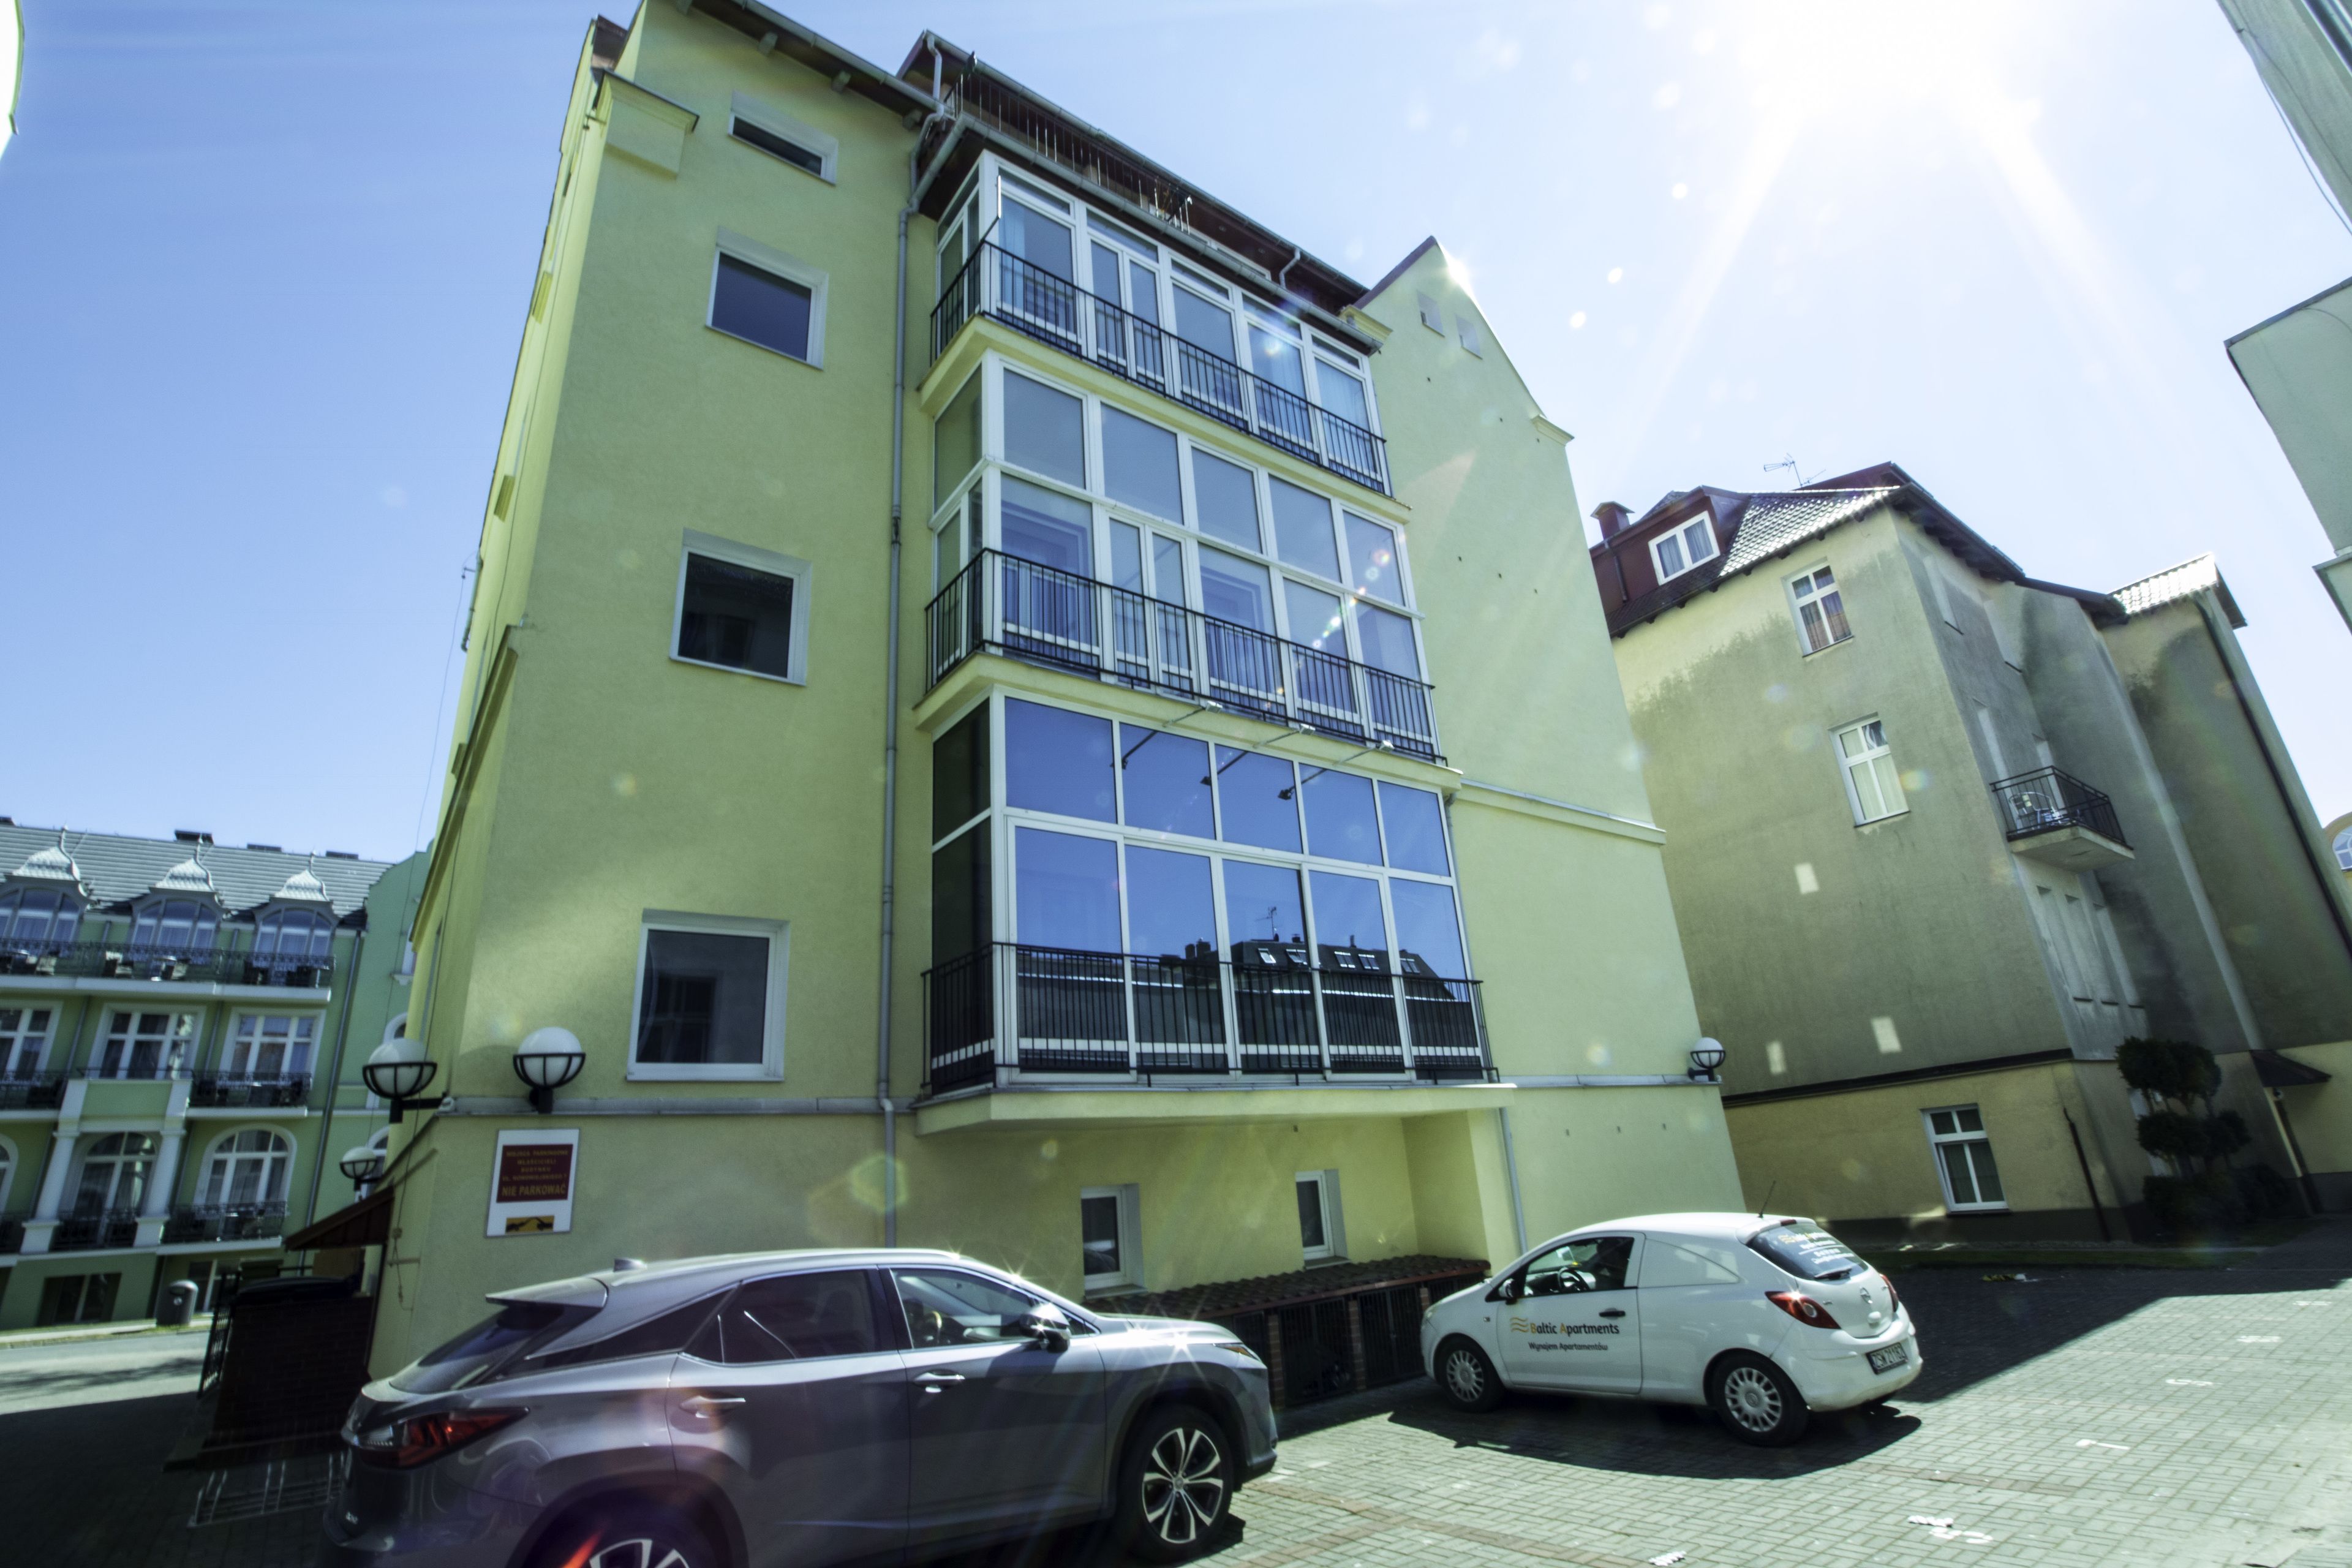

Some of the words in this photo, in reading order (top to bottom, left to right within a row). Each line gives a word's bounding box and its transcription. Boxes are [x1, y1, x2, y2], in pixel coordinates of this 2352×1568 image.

[502, 1185, 518, 1196] NIE
[519, 1182, 566, 1196] PARKOWAĆ
[1530, 1322, 1558, 1334] Baltic
[1559, 1322, 1620, 1336] Apartments
[1528, 1341, 1558, 1351] Wynajem
[1559, 1341, 1608, 1351] Apartamentów
